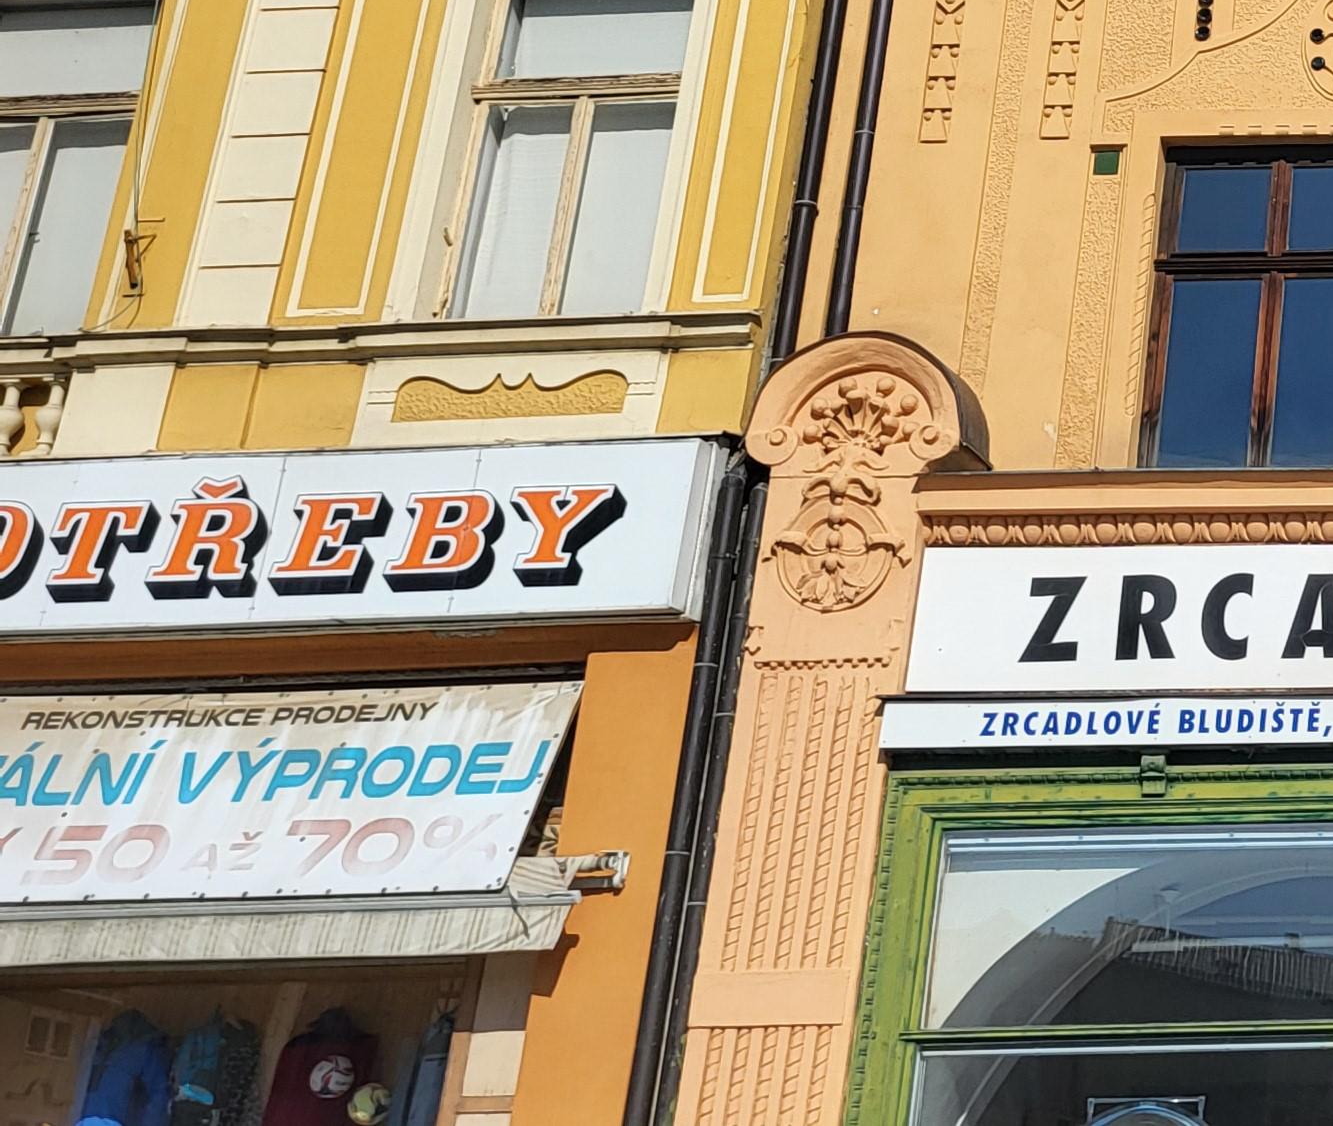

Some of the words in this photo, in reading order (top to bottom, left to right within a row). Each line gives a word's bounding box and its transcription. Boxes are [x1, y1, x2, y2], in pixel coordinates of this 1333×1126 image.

[21, 708, 265, 730] REKONSTRUKCE
[270, 702, 439, 726] PRODEJNY
[980, 703, 1161, 737] ZRCADLOVÉ
[1178, 702, 1332, 737] BLUDIŠTĚ,
[0, 740, 168, 806] ÁLNÍ
[178, 737, 551, 804] VÝPRODEJ
[20, 824, 170, 886] 50
[180, 831, 264, 878] AŽ
[286, 814, 503, 878] 70%
